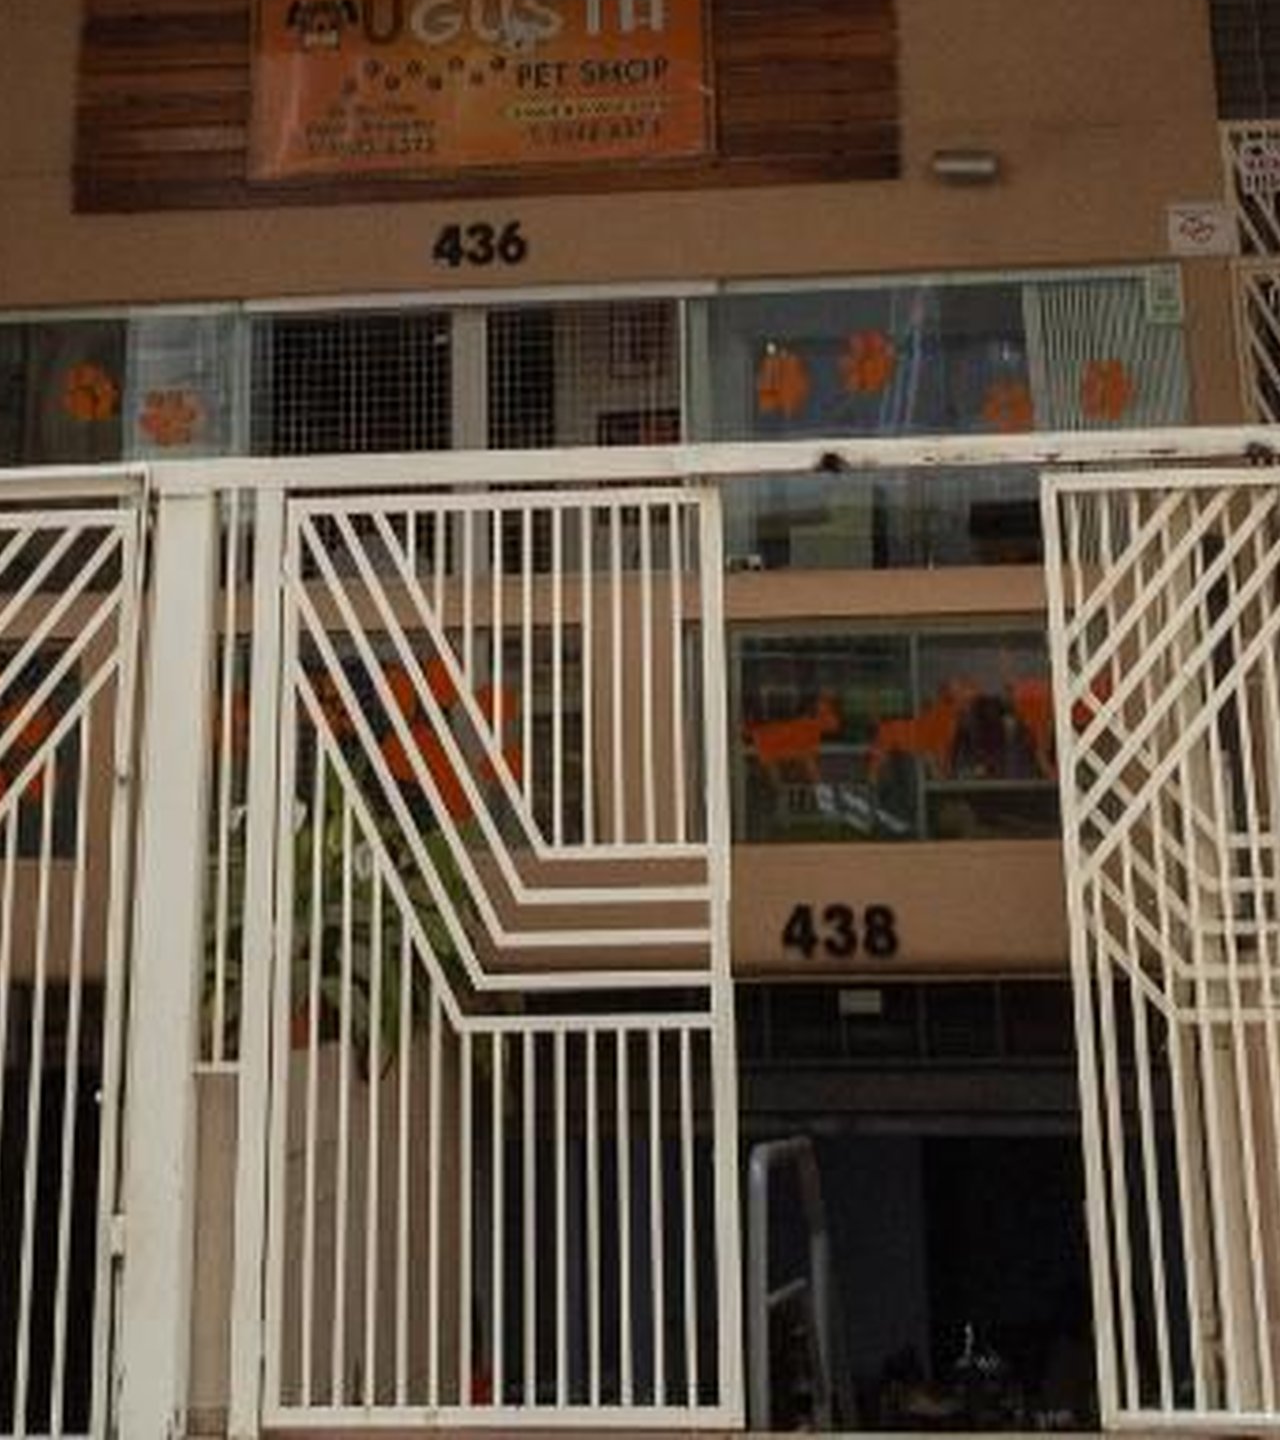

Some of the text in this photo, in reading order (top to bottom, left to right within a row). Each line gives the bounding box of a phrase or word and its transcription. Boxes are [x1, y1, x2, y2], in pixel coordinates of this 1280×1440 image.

[578, 56, 668, 86] SHOP
[432, 220, 528, 268] 436
[781, 904, 899, 960] 438
